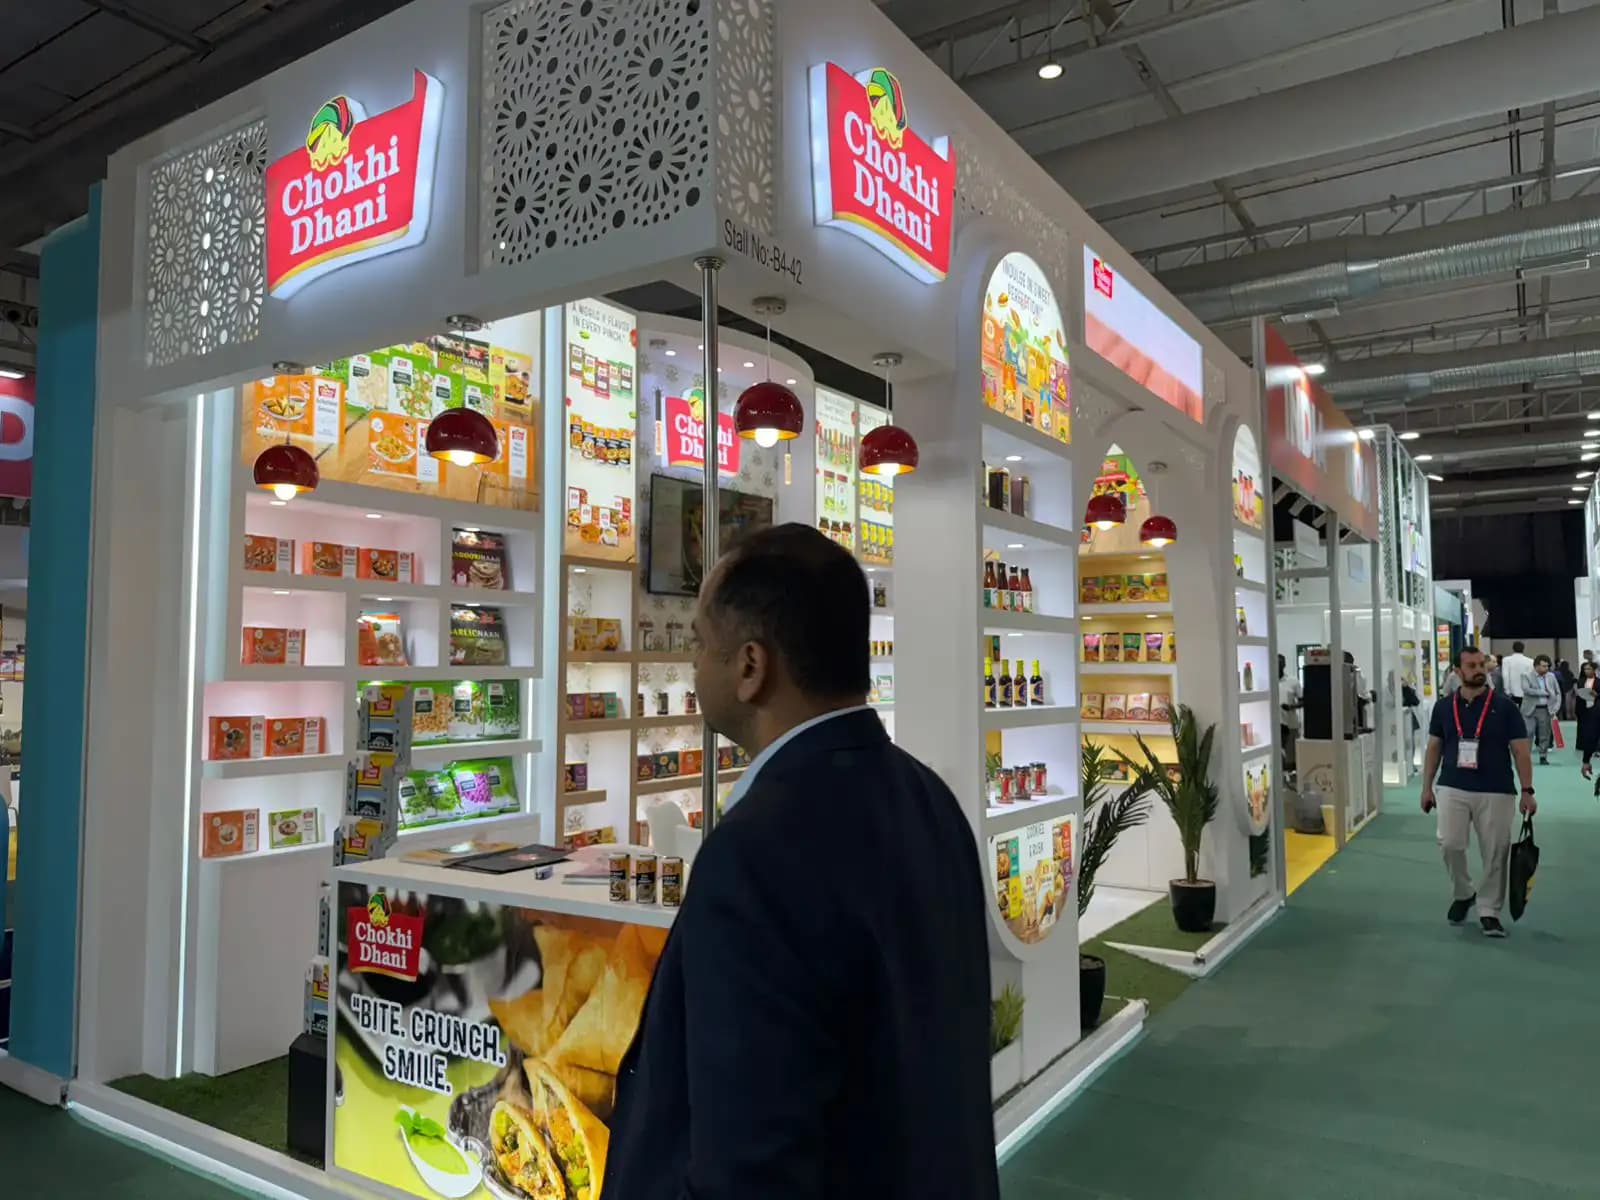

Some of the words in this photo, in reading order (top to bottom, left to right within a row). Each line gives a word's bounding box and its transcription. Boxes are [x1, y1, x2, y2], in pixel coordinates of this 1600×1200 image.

[281, 135, 401, 217] Chokhi
[843, 111, 940, 216] Chokhi
[289, 183, 389, 256] Dhani
[853, 159, 933, 252] Dhani
[724, 218, 748, 253] Stall
[675, 413, 733, 447] Chohi
[680, 435, 729, 465] Dhi
[355, 922, 413, 950] Chokhi
[359, 943, 408, 970] Dhani
[352, 996, 406, 1037] "BITE.
[412, 1010, 504, 1064] CRUNCH.
[385, 1045, 451, 1092] SMILE.
